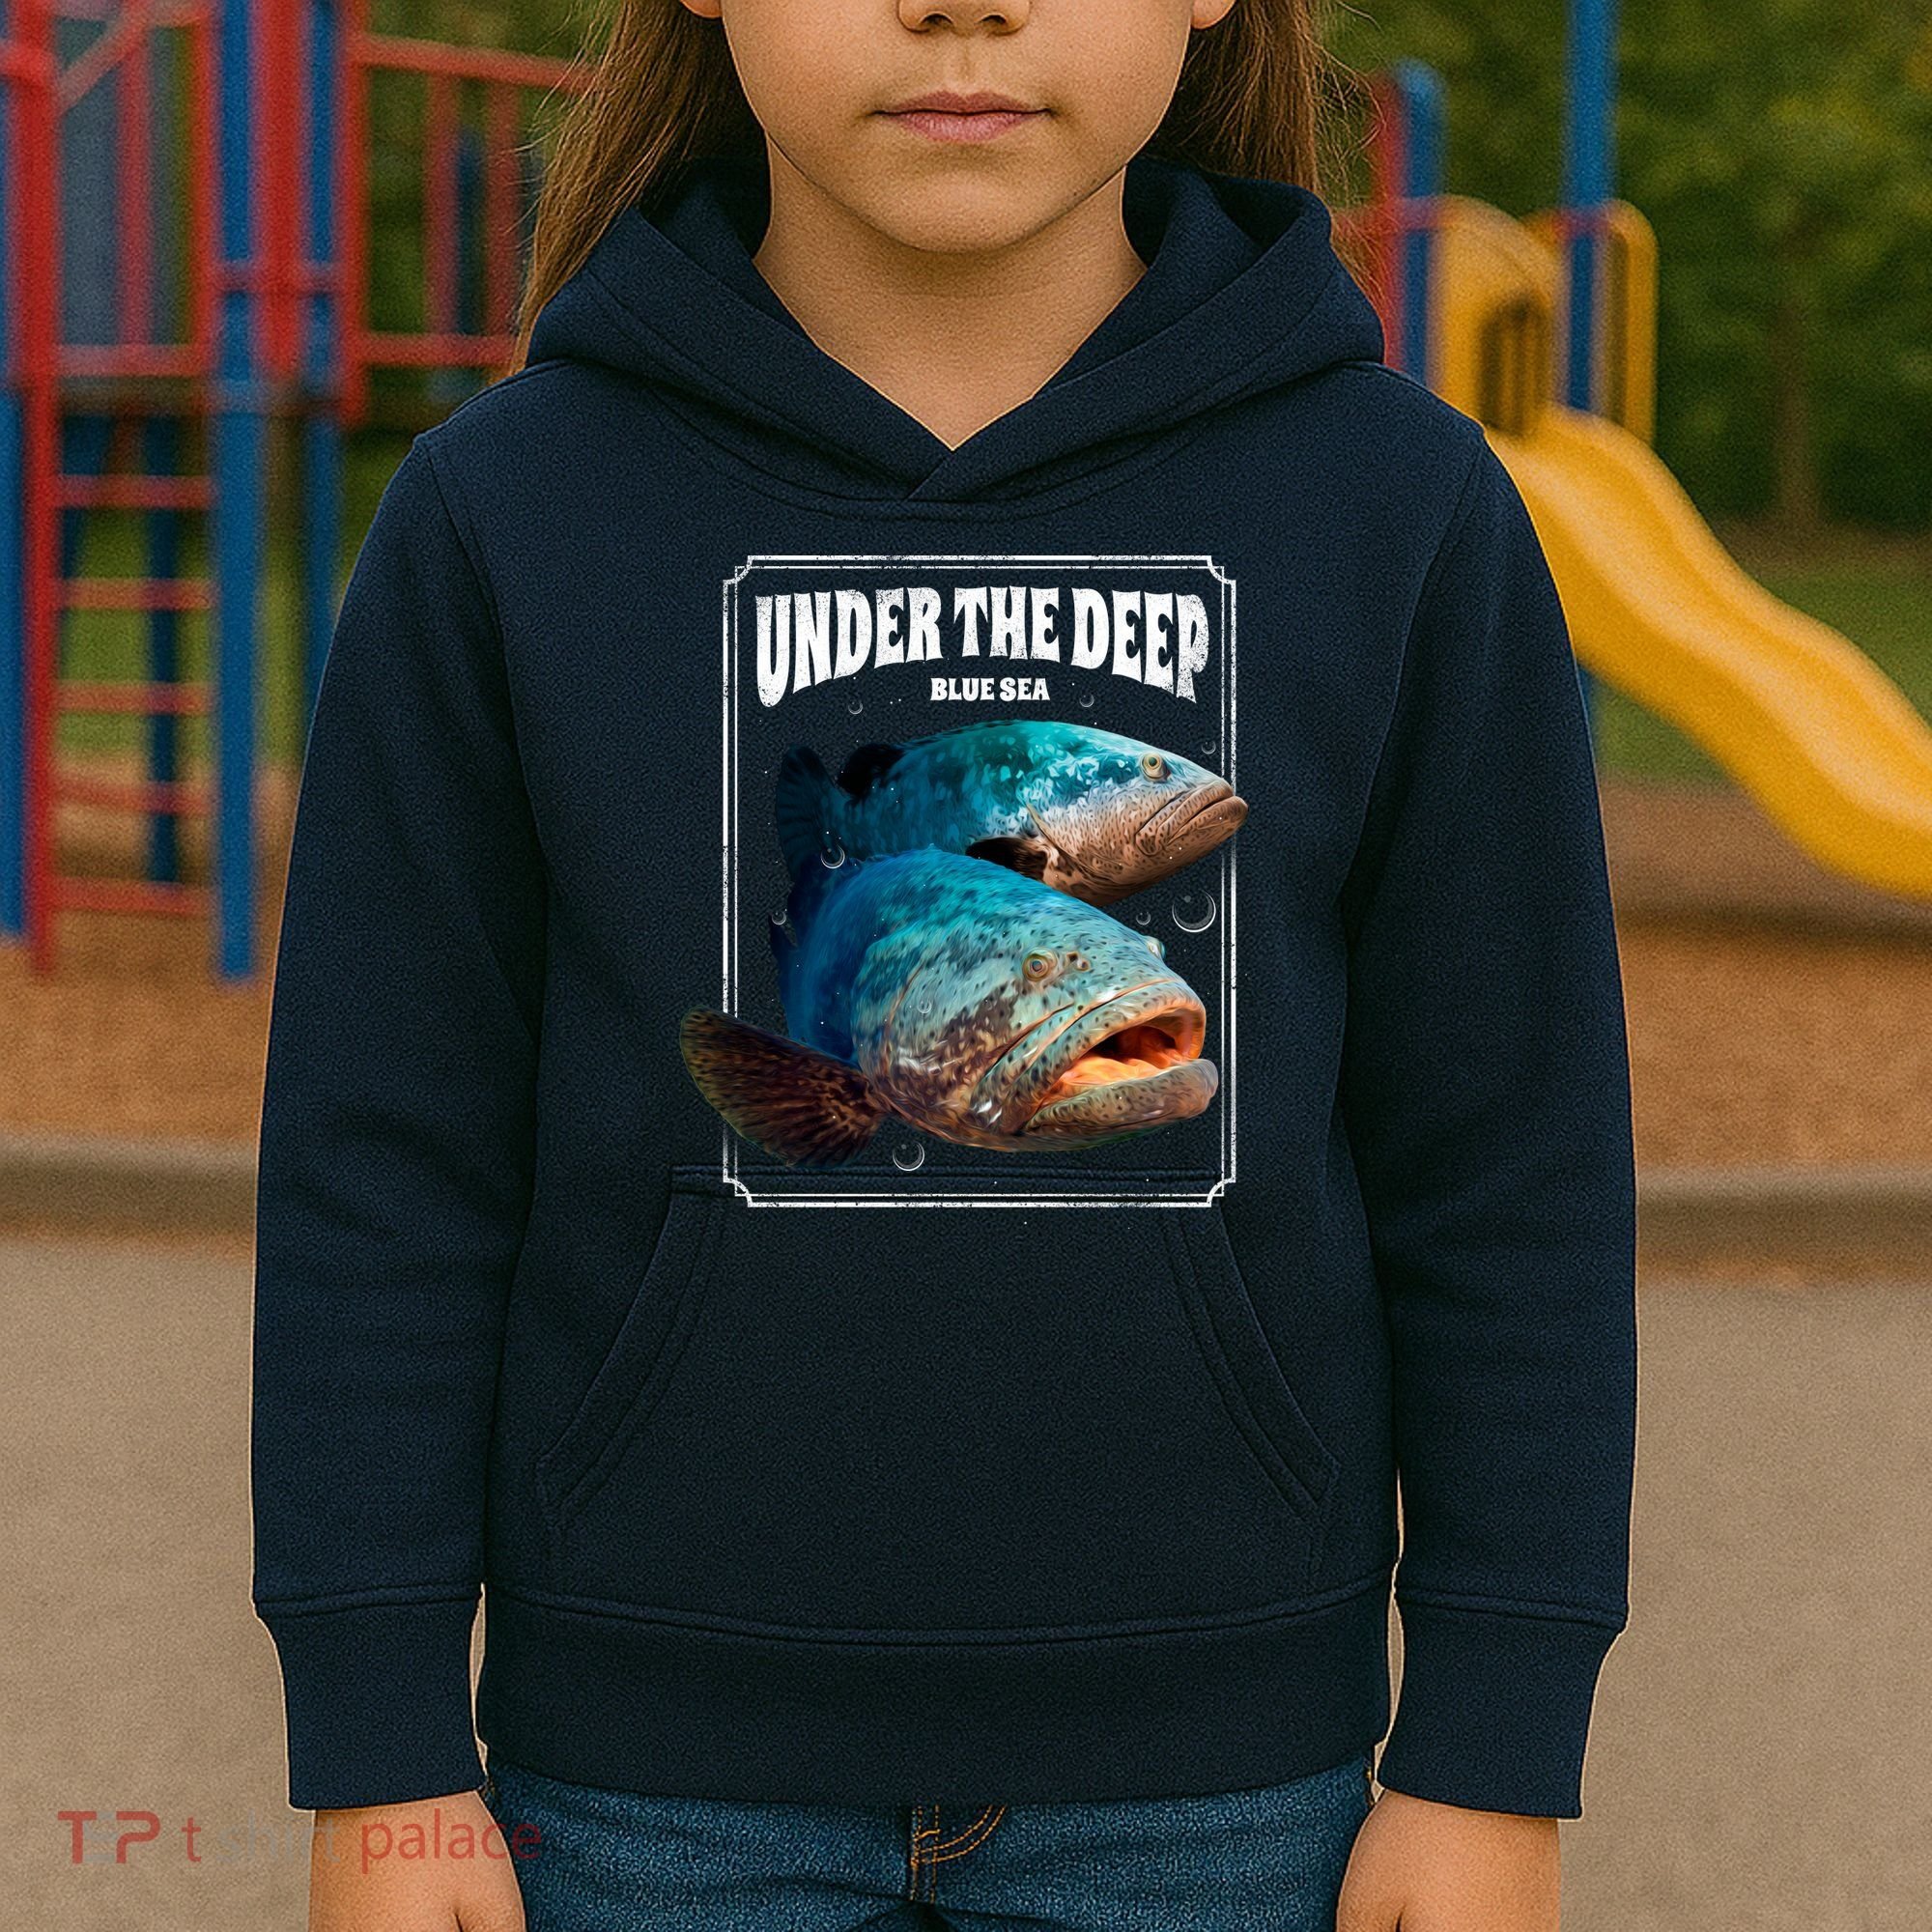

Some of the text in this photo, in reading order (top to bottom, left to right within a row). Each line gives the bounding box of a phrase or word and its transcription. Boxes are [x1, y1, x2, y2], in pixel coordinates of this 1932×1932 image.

[755, 585, 1209, 707] UNDER THE DEEP
[930, 677, 1051, 702] BLUE SEA
